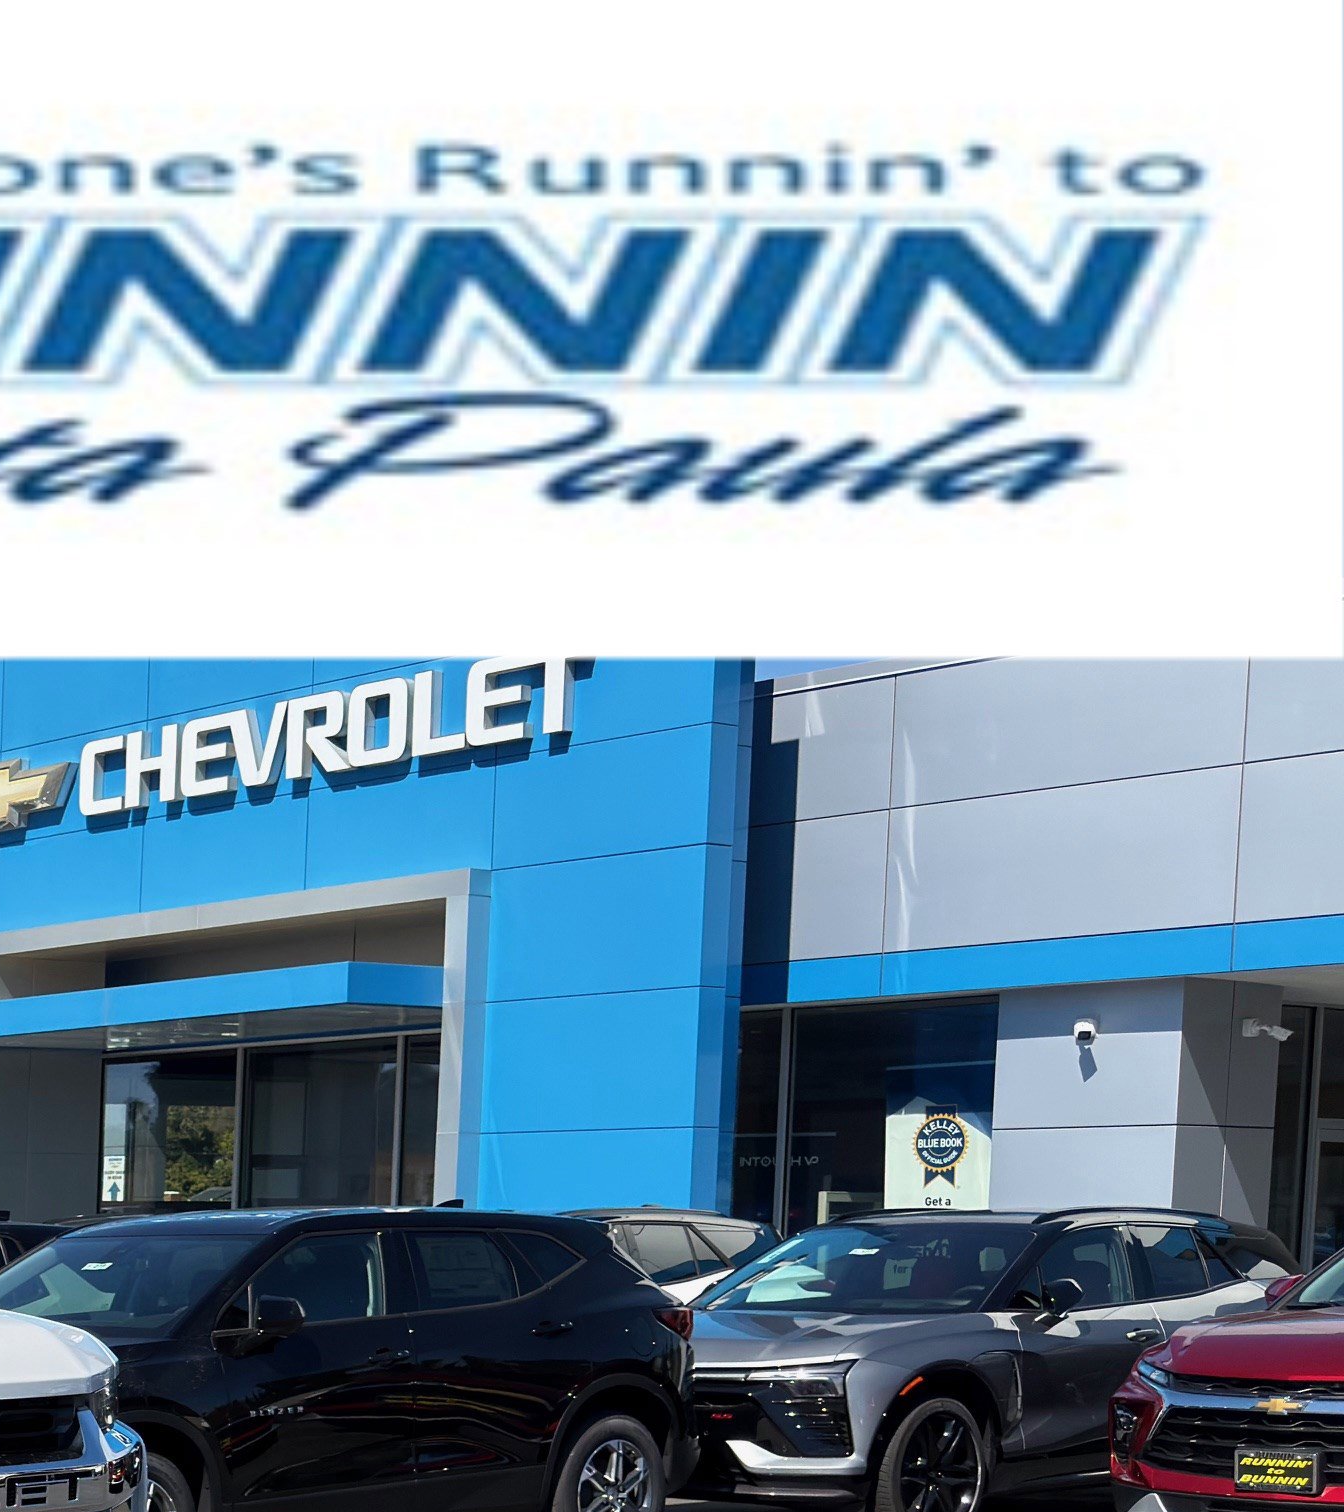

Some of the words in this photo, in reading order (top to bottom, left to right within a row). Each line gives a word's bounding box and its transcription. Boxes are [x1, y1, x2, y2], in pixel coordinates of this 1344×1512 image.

[79, 657, 575, 817] CHEVROLET
[922, 1120, 961, 1135] KELLEY
[917, 1139, 939, 1149] BLUE
[940, 1138, 963, 1148] BOOK
[925, 1196, 942, 1206] Get
[945, 1198, 951, 1206] a
[1266, 1467, 1285, 1475] to
[1240, 1474, 1309, 1486] BUNNIN
